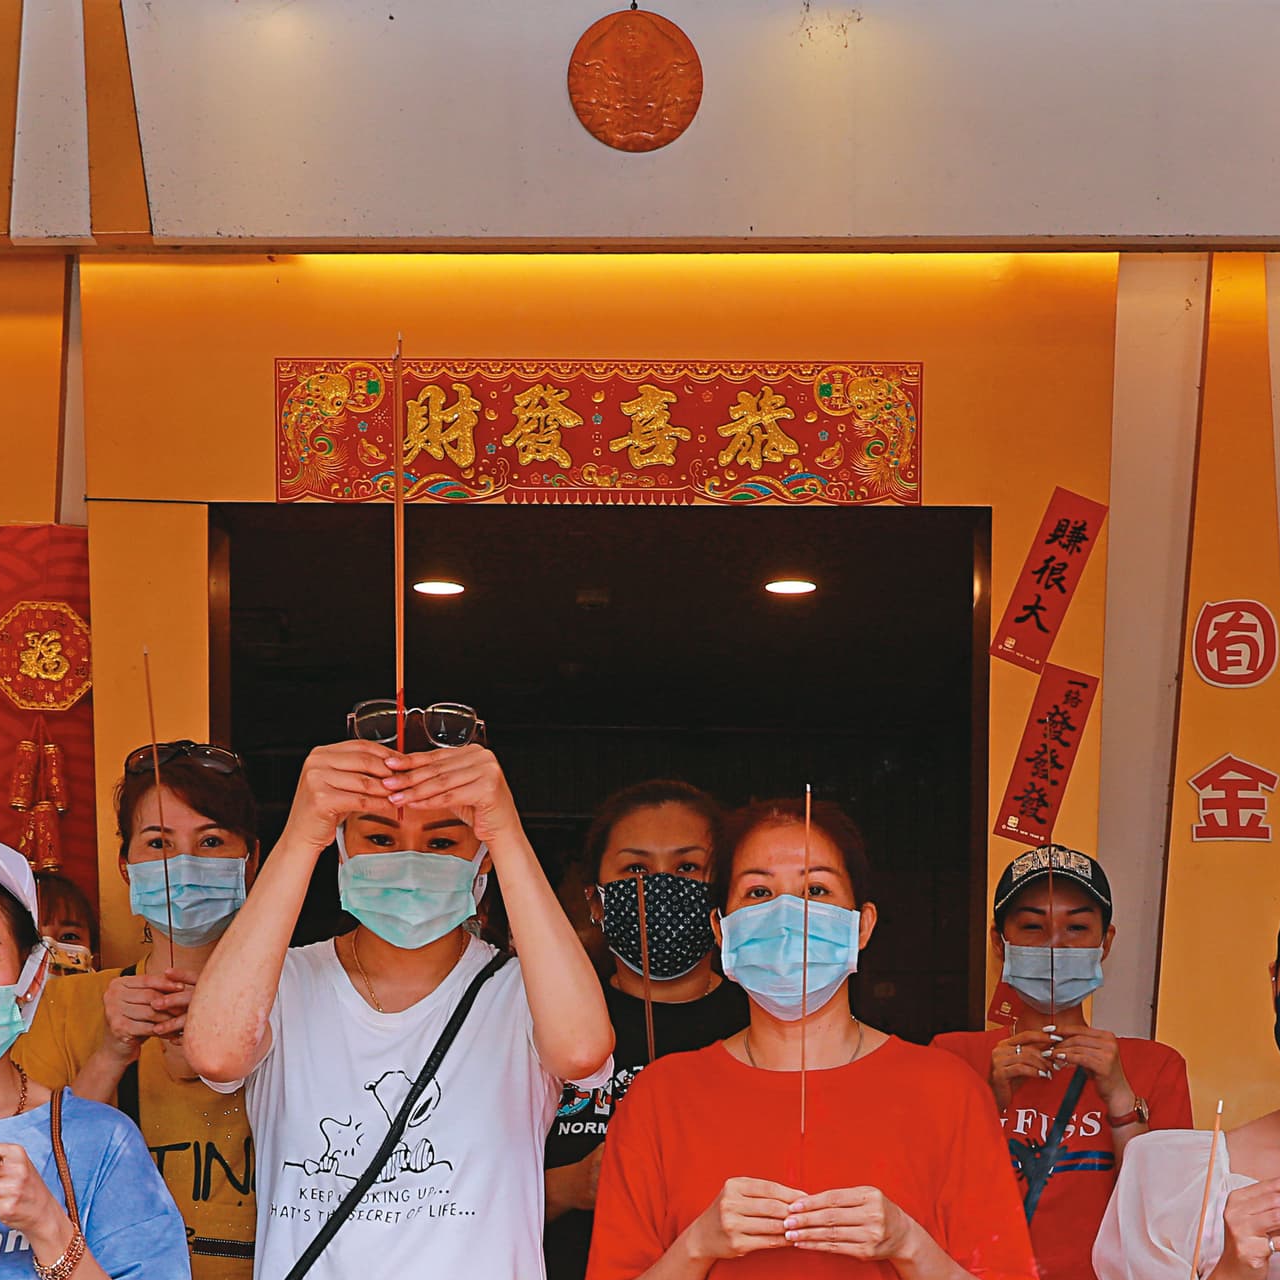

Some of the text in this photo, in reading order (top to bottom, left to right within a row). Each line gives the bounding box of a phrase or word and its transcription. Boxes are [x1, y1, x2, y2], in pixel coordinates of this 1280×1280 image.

[1014, 518, 1089, 633] 賺很大
[20, 630, 70, 681] 福
[148, 1136, 256, 1202] TIN
[298, 1187, 334, 1203] KEEP
